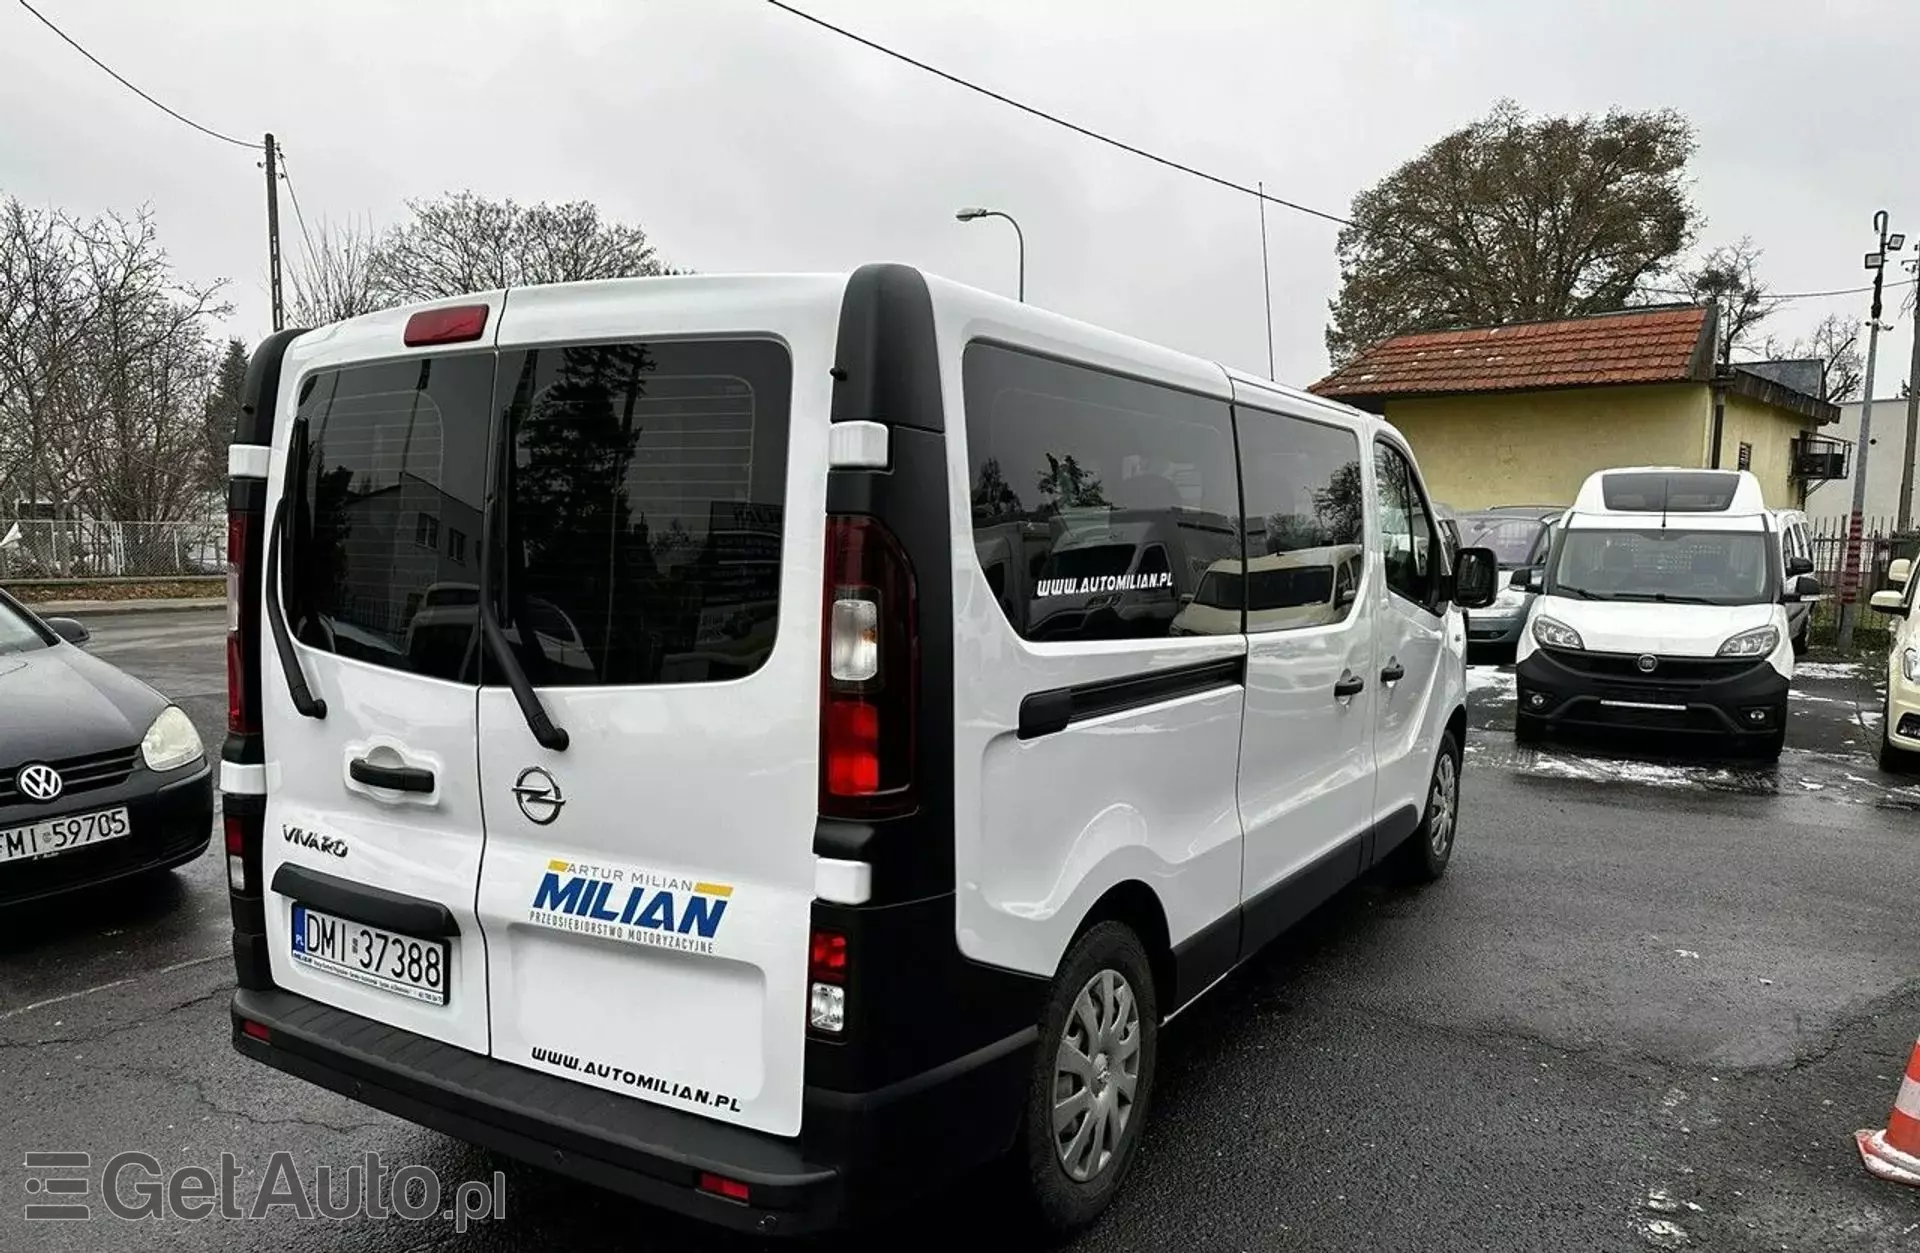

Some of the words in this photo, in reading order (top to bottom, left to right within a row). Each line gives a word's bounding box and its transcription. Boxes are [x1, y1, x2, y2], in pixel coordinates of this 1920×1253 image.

[1037, 572, 1173, 597] WWW.AUTOMILIAN.PL
[52, 810, 126, 847] 59705
[282, 824, 349, 858] VIVARO
[566, 862, 624, 882] ARTUR
[631, 872, 693, 892] MILIAN
[532, 872, 728, 938] MILIAN
[307, 913, 346, 962] DMI
[359, 929, 441, 987] 37388
[628, 931, 713, 954] MOTORYZACYJNE
[531, 1047, 742, 1113] WWW.AUTOMILIAN.PL
